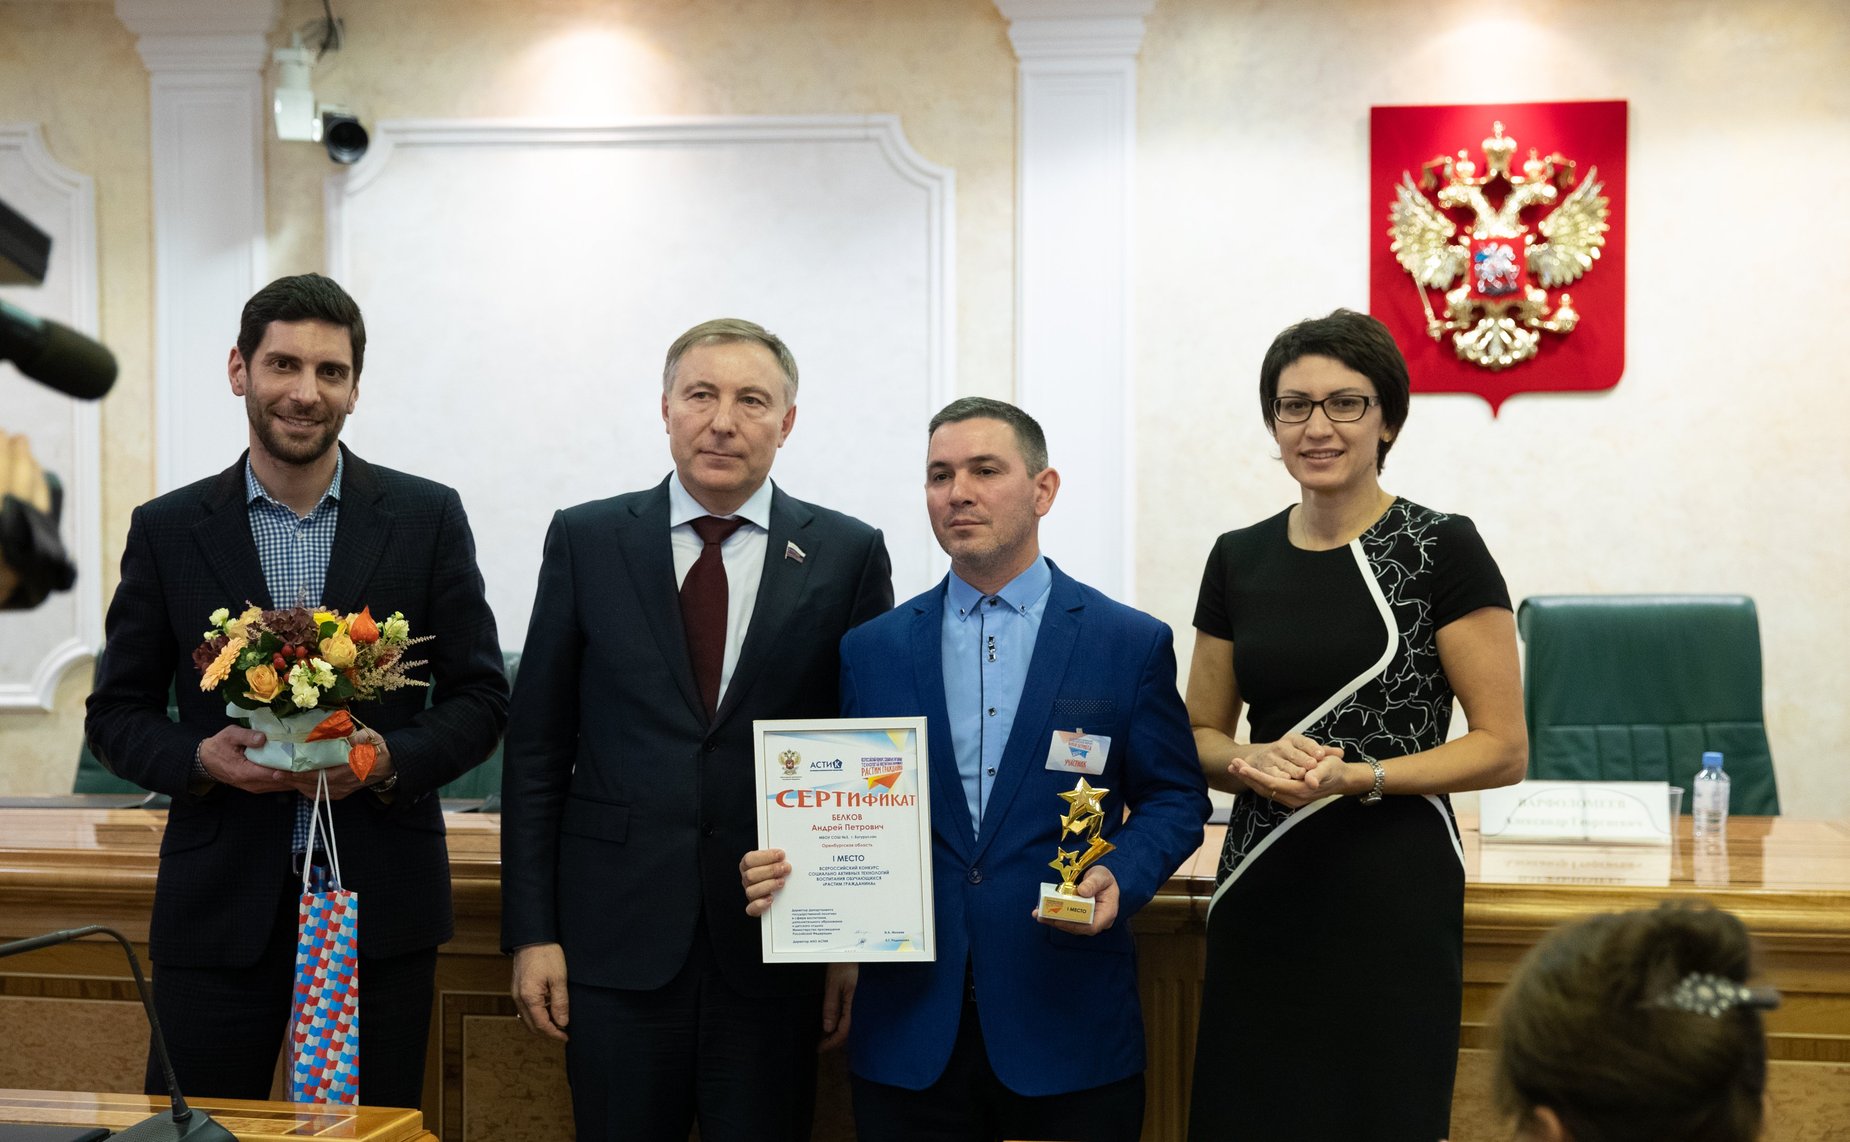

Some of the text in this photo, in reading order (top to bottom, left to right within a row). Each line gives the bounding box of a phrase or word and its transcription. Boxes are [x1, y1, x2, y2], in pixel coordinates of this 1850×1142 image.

[810, 758, 843, 769] АСТИК
[775, 789, 916, 808] СЕРТИФИКАТ
[832, 813, 863, 821] БЕЛКОВ
[811, 823, 884, 832] Андрей Петрович
[1070, 906, 1087, 914] МЕСТО
